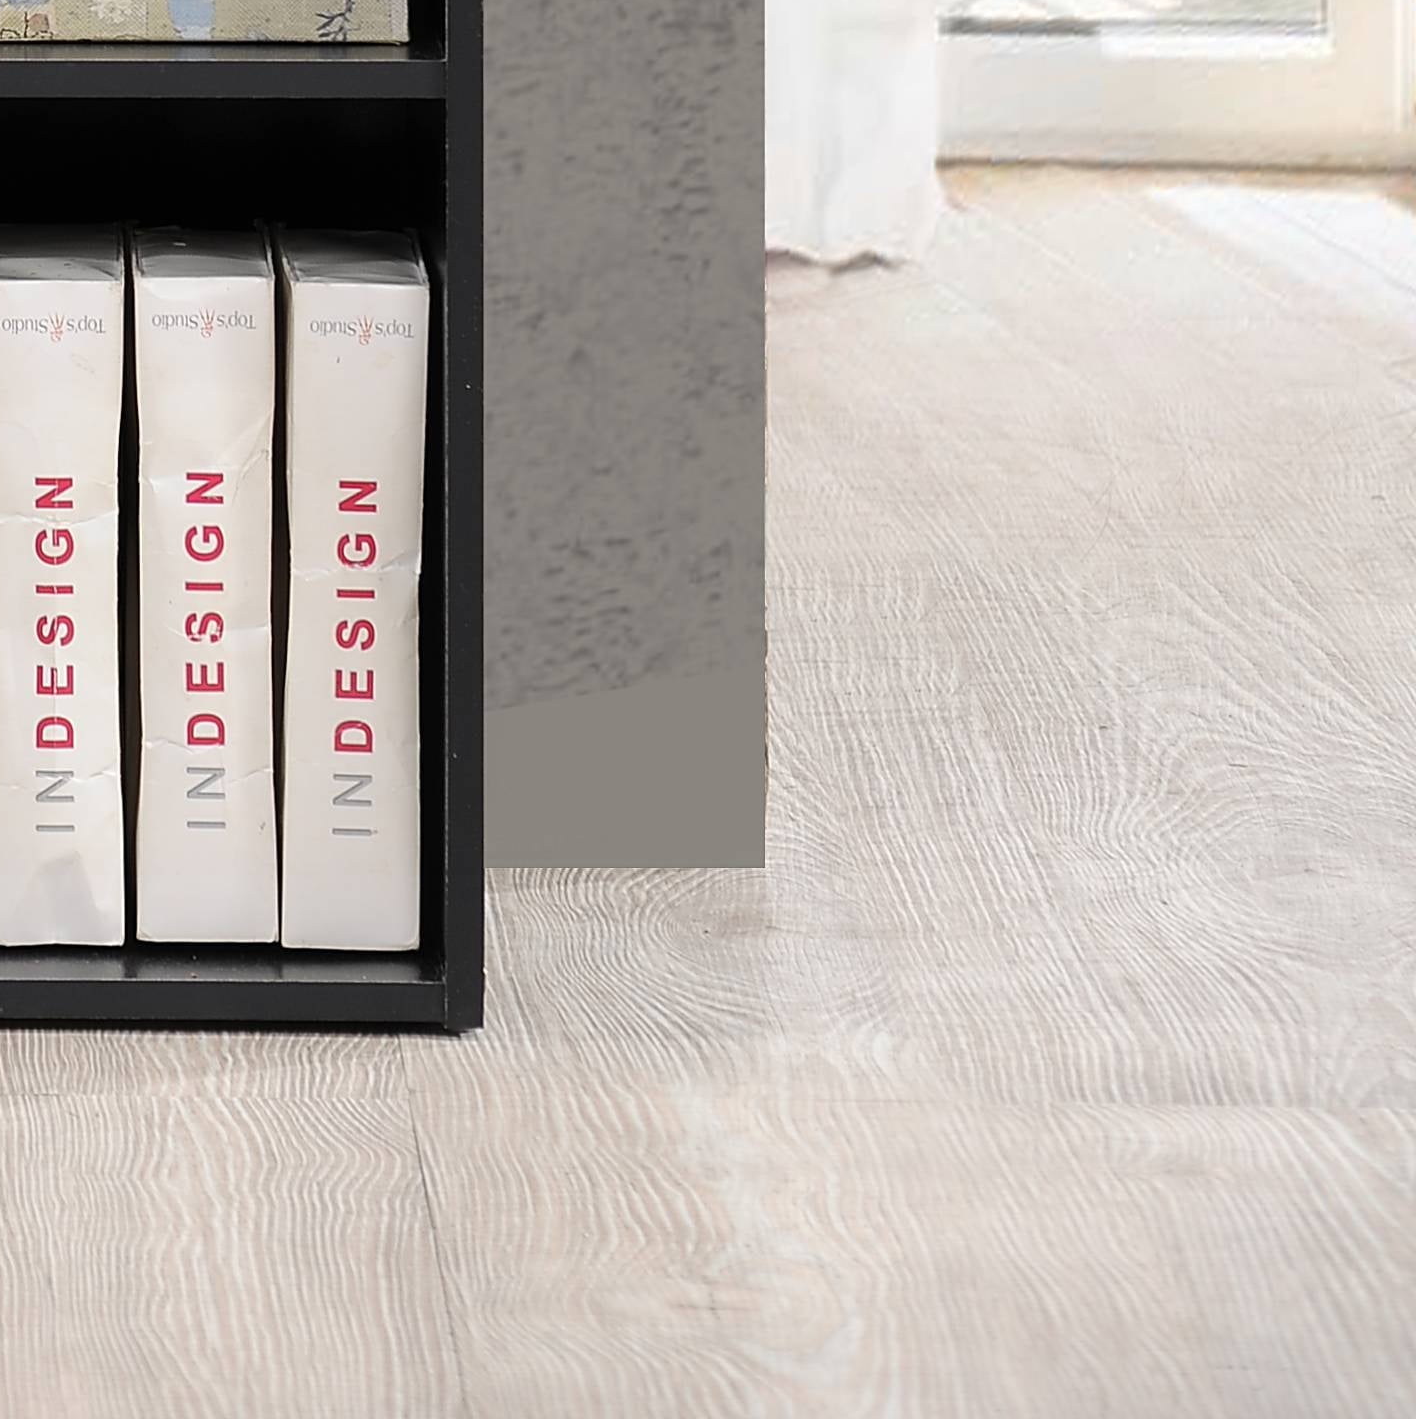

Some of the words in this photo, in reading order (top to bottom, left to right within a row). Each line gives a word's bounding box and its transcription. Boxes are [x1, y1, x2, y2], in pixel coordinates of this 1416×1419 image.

[2, 316, 50, 336] Studio
[66, 316, 106, 336] Top's
[152, 312, 200, 331] Studio
[217, 311, 256, 332] Top's
[310, 319, 358, 338] Studio
[375, 318, 415, 339] Top's
